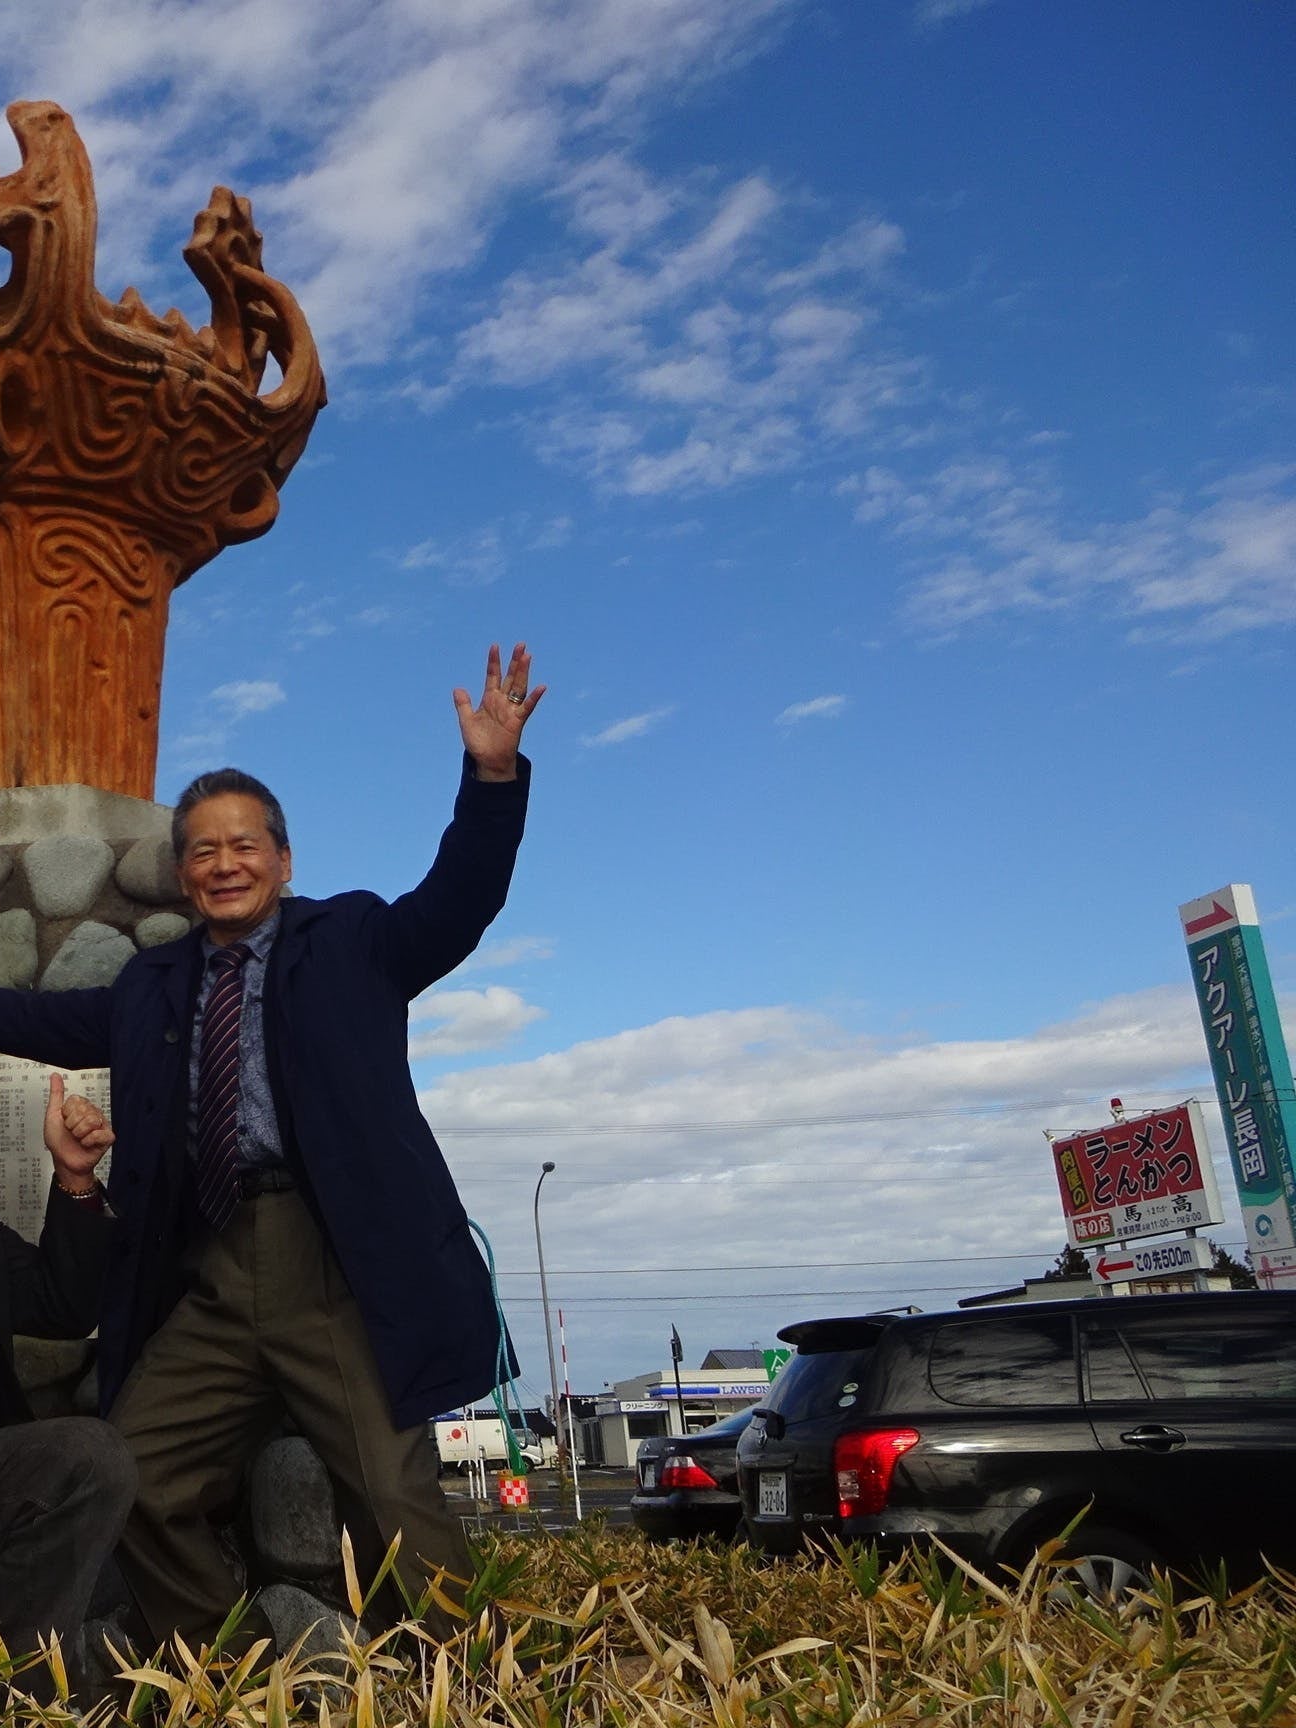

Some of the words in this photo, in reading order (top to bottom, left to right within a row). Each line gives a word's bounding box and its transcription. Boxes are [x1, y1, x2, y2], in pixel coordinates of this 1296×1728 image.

[1197, 945, 1267, 1183] アクアーレ長岡
[1085, 1119, 1183, 1170] ラーメン
[1093, 1152, 1193, 1205] とんかつ
[1075, 1215, 1112, 1238] 味の店
[1135, 1246, 1193, 1272] この先500m
[722, 1385, 770, 1395] LAWSON
